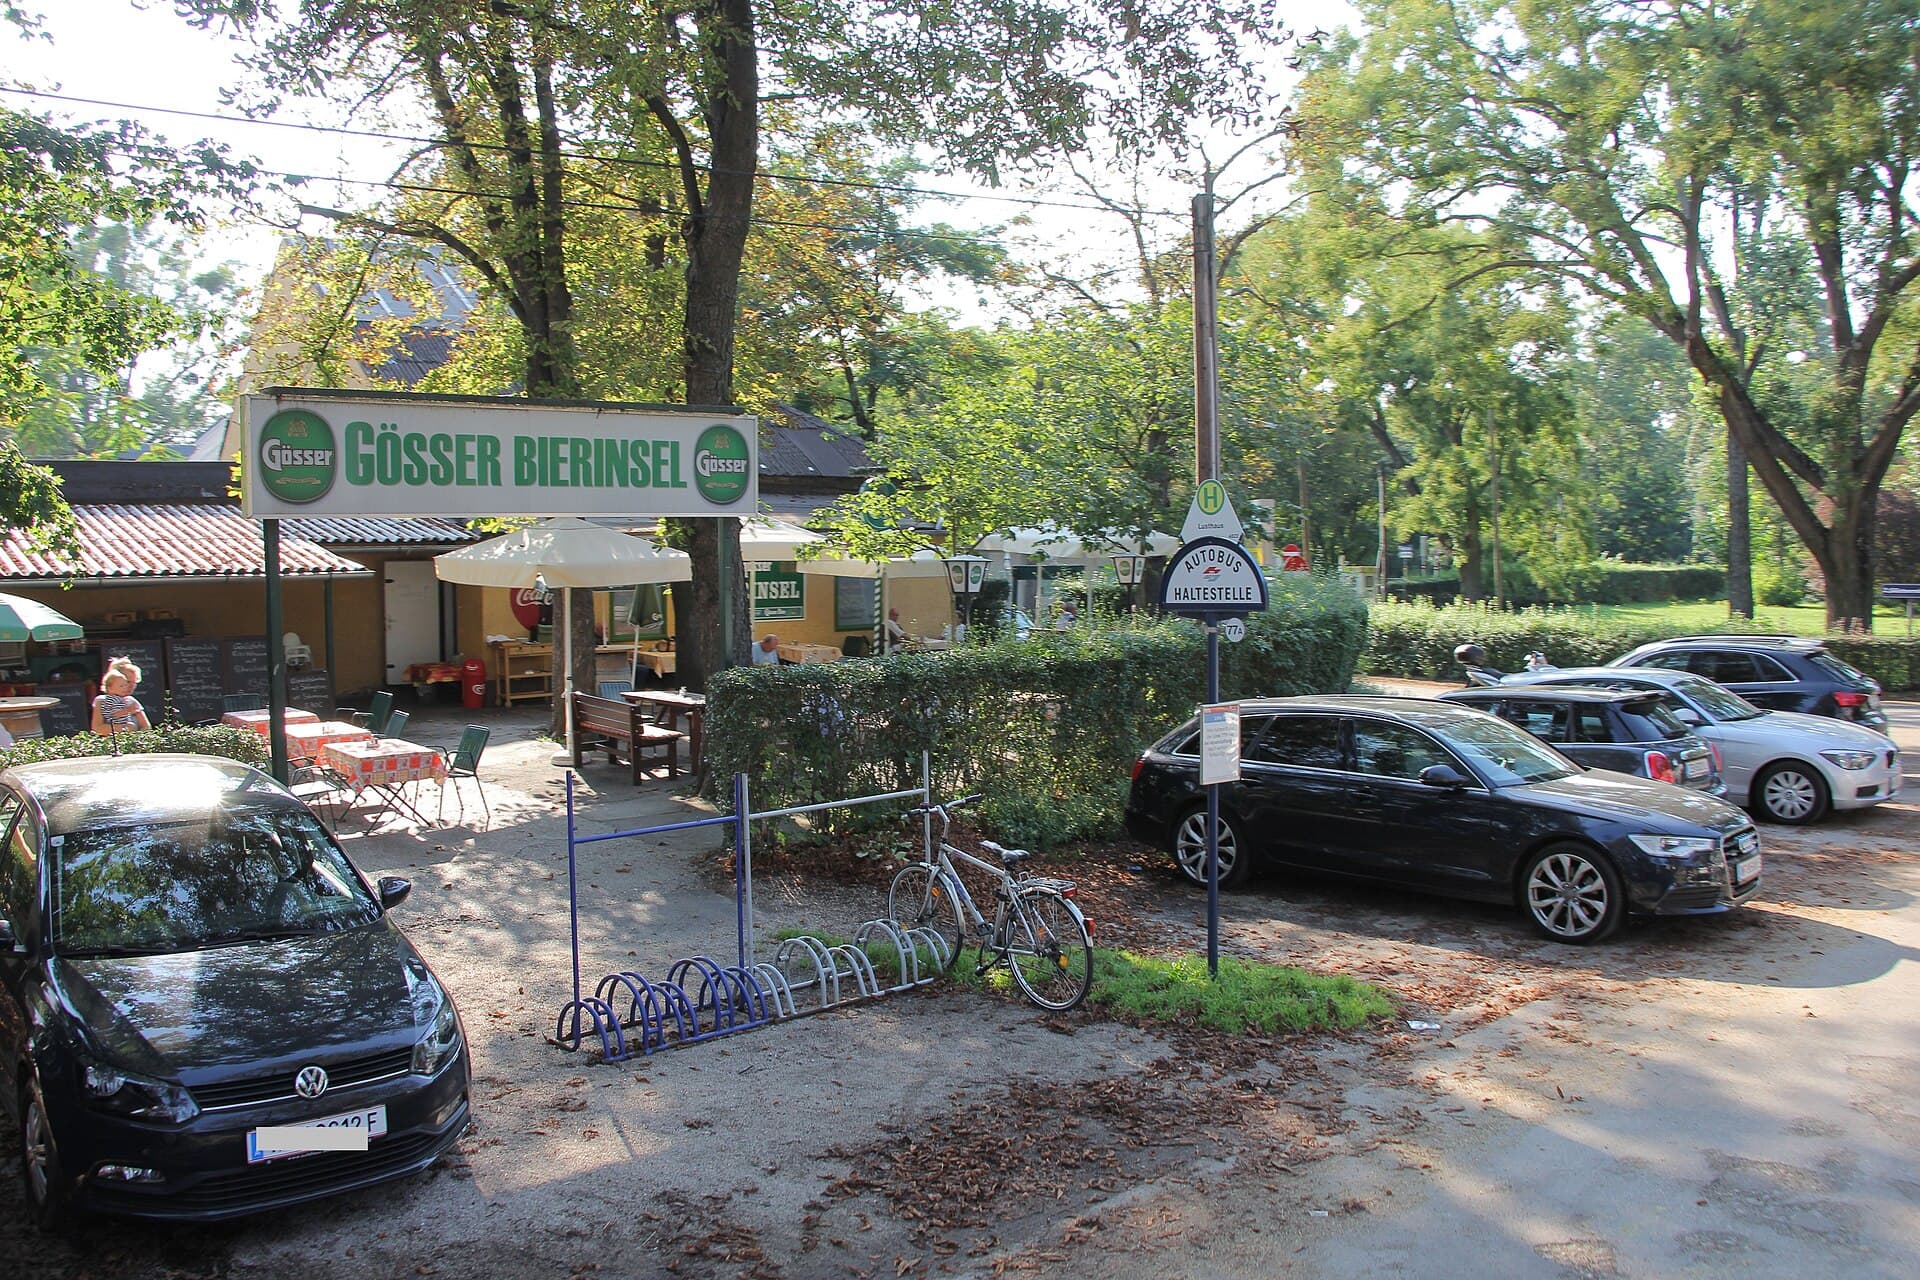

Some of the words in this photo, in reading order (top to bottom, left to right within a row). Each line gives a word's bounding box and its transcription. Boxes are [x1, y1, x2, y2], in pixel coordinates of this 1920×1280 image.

[261, 438, 333, 472] Gösser
[344, 421, 502, 486] GÖSSER
[514, 435, 688, 488] BIERINSEL
[695, 449, 747, 477] Gösser
[1203, 487, 1218, 509] H
[1184, 548, 1242, 573] AUTOBUS
[1174, 586, 1253, 601] HALTESTELLE
[1226, 625, 1243, 636] 77A
